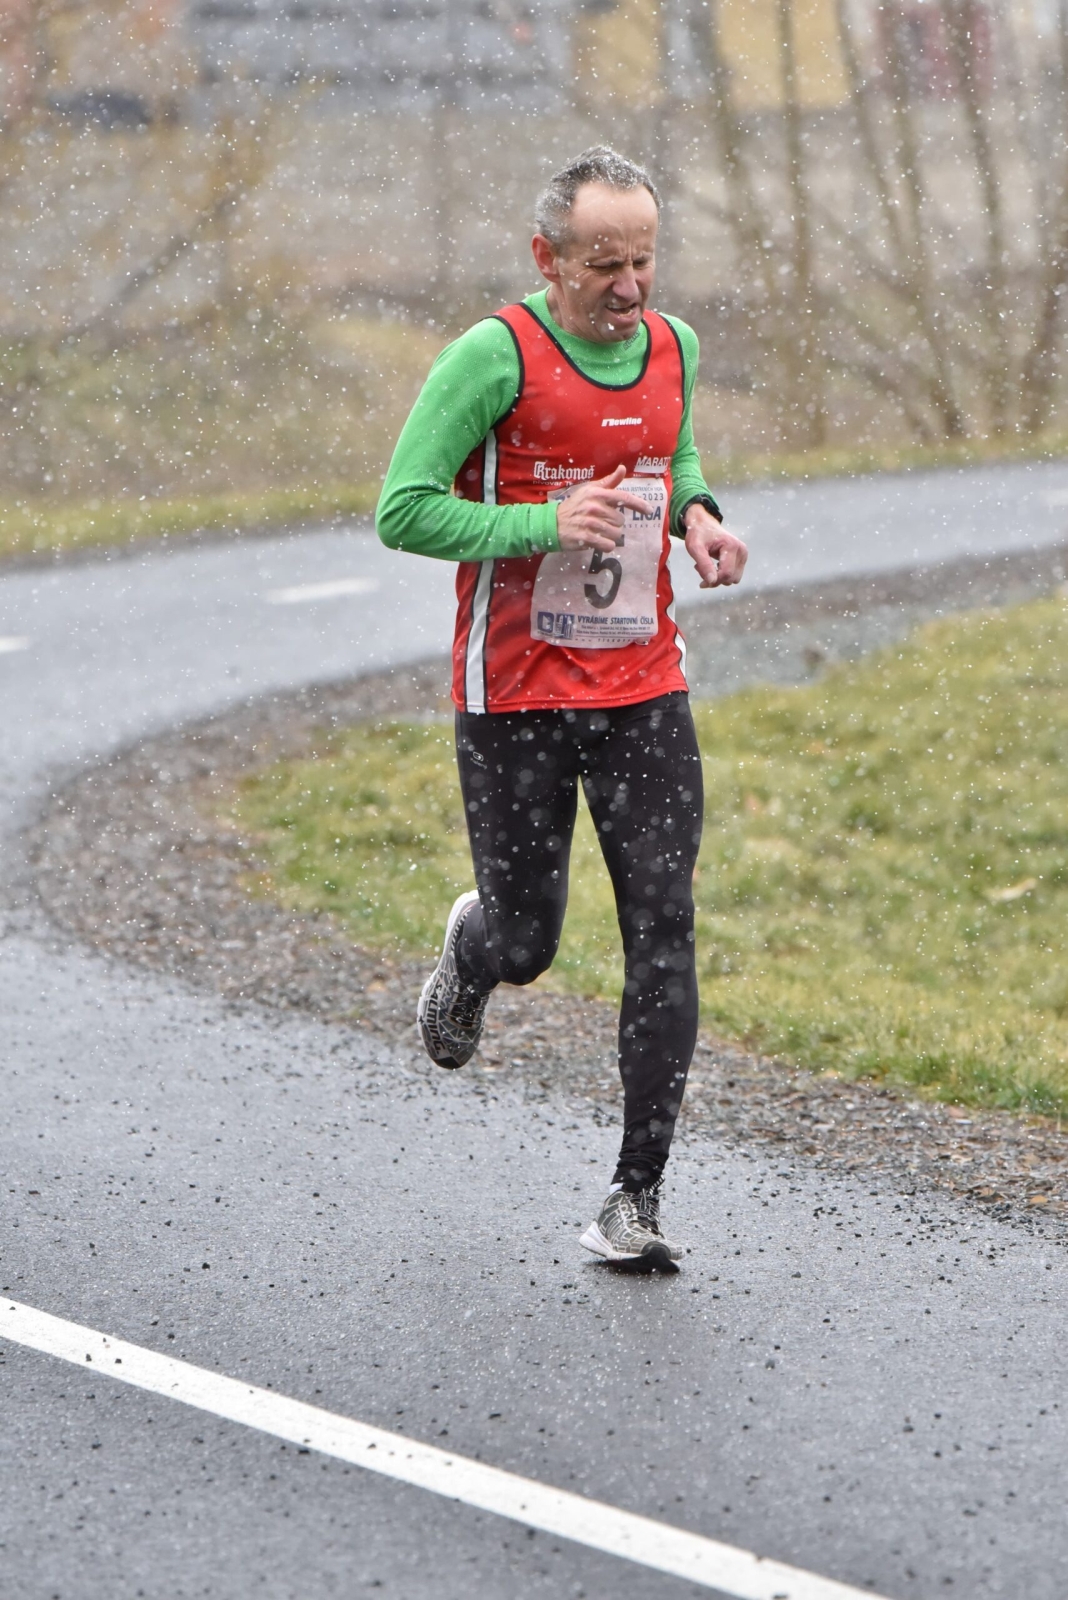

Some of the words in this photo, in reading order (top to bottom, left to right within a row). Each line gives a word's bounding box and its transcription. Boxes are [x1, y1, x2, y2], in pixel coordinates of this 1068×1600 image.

[533, 460, 595, 481] Krakonoš
[584, 534, 625, 609] 5
[610, 615, 638, 625] STARTOVNÍ
[640, 615, 655, 625] ČÍSLA
